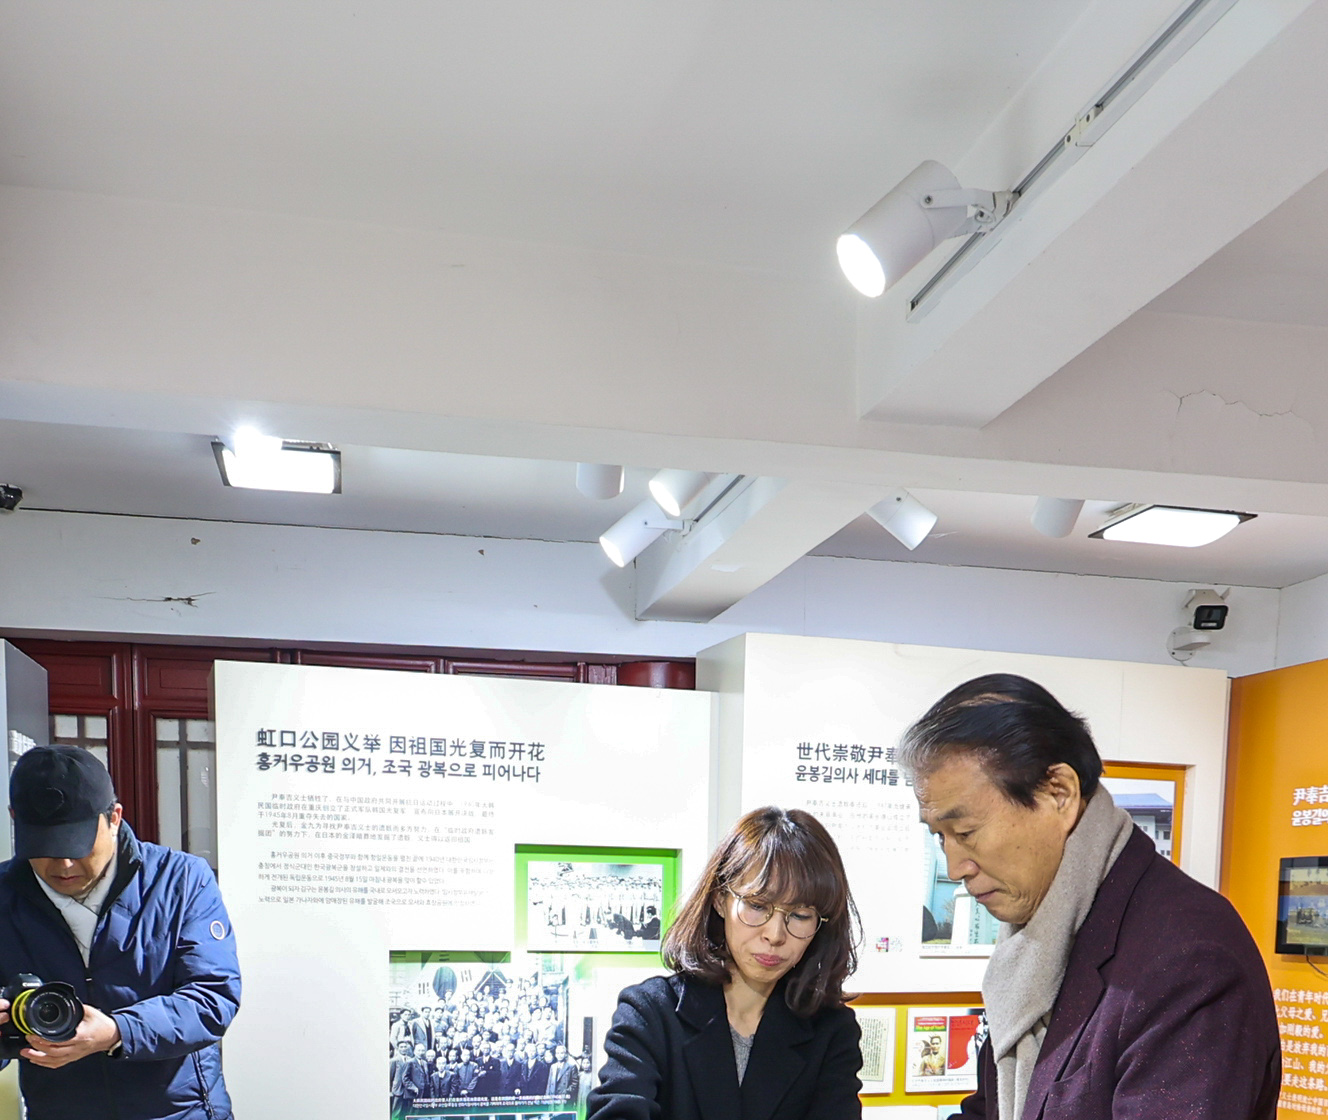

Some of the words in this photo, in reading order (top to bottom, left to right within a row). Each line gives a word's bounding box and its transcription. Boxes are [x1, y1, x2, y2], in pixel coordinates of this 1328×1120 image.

[256, 727, 381, 753] 虹口公园义举
[389, 735, 546, 761] 因祖国光复而开花
[256, 752, 336, 773] 홍커우공원
[341, 757, 377, 776] 의거,
[382, 759, 413, 777] 조국
[417, 760, 478, 778] 광복으로
[482, 764, 541, 783] 피어나다
[795, 764, 859, 785] 윤봉길의사
[862, 768, 900, 786] 세대를
